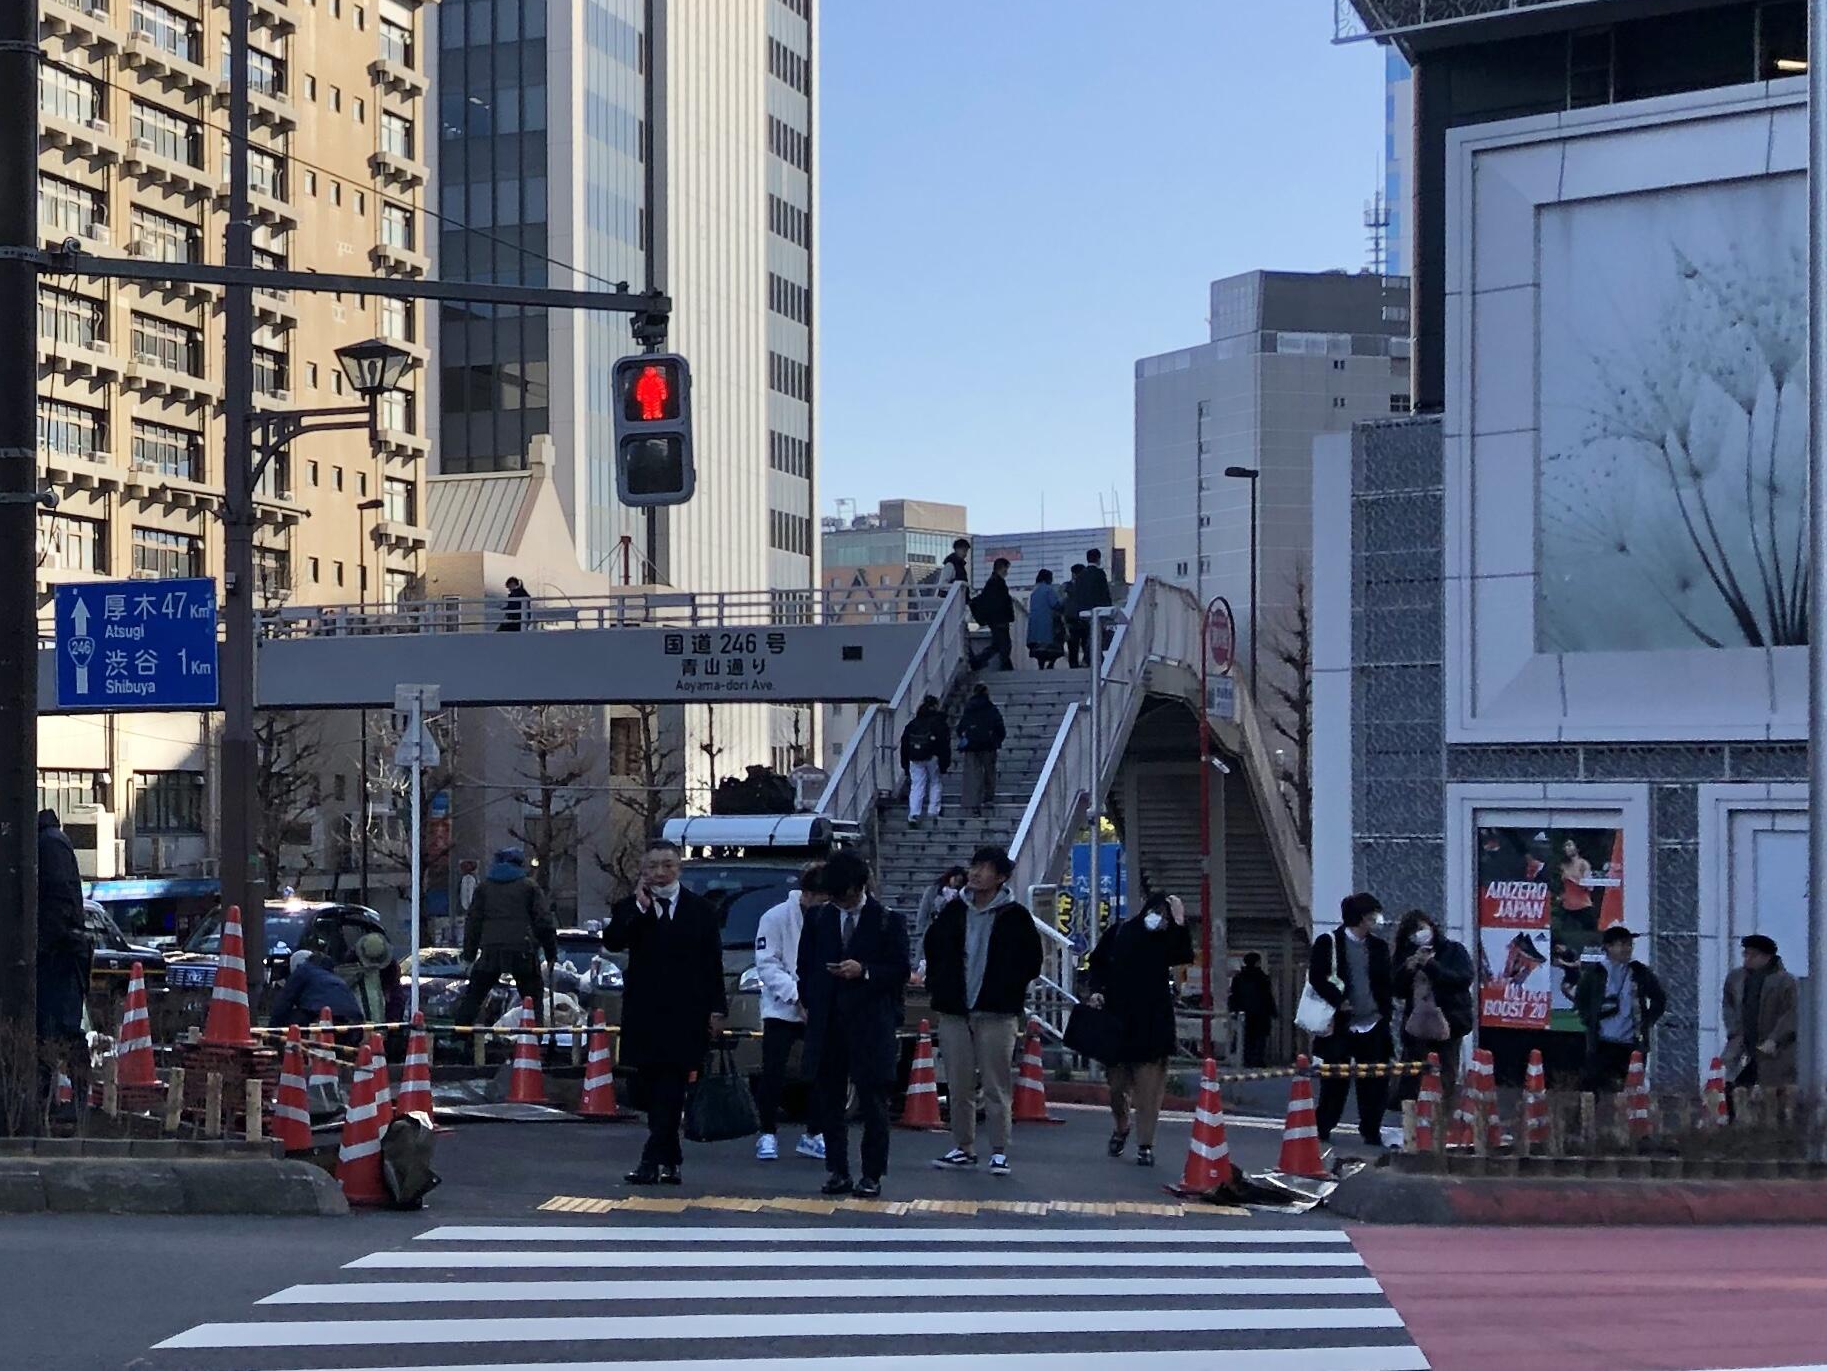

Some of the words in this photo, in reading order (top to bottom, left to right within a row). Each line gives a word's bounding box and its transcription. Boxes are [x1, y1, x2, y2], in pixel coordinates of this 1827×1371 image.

[103, 593, 157, 620] 厚木
[105, 624, 145, 641] Atsugi
[71, 640, 91, 655] 246
[664, 632, 787, 655] 国道246号
[105, 649, 159, 676] 渋谷
[681, 658, 767, 677] 青山通り
[105, 680, 156, 696] Shibuya
[675, 679, 749, 694] Aoyama-dori
[751, 679, 776, 691] Ave.
[1076, 875, 1112, 886] 六木
[1485, 881, 1548, 900] ADIZERO
[1493, 900, 1546, 919] JAPAN
[1503, 982, 1548, 1002] ULTRA
[1483, 999, 1528, 1018] BOOST
[1529, 1002, 1548, 1019] 20
